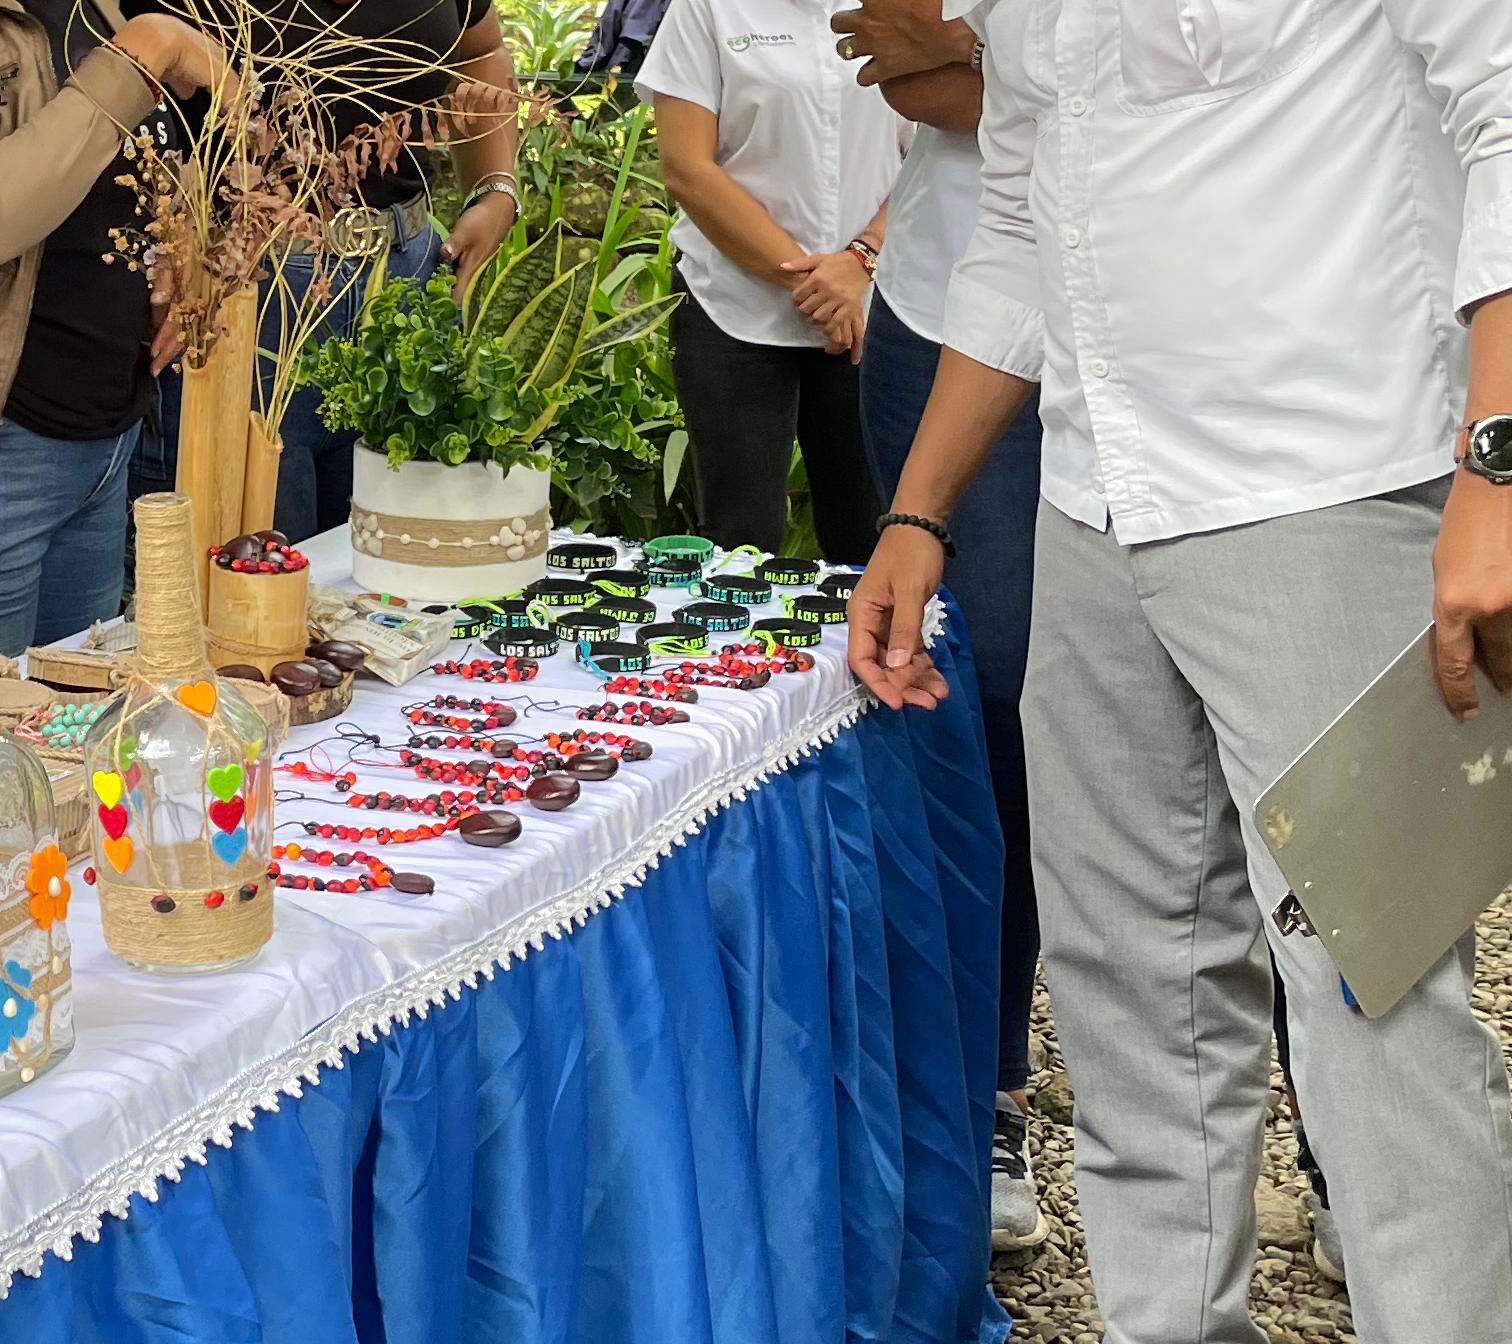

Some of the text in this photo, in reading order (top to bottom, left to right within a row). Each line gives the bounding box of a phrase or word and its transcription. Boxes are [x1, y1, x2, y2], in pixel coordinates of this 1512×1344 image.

[548, 553, 567, 567] LOS
[707, 584, 728, 602] LOS
[797, 609, 819, 623] LOS
[556, 624, 574, 641] LOS
[785, 635, 807, 647] LOS
[500, 643, 524, 657] LOS
[619, 656, 643, 671] LOS
